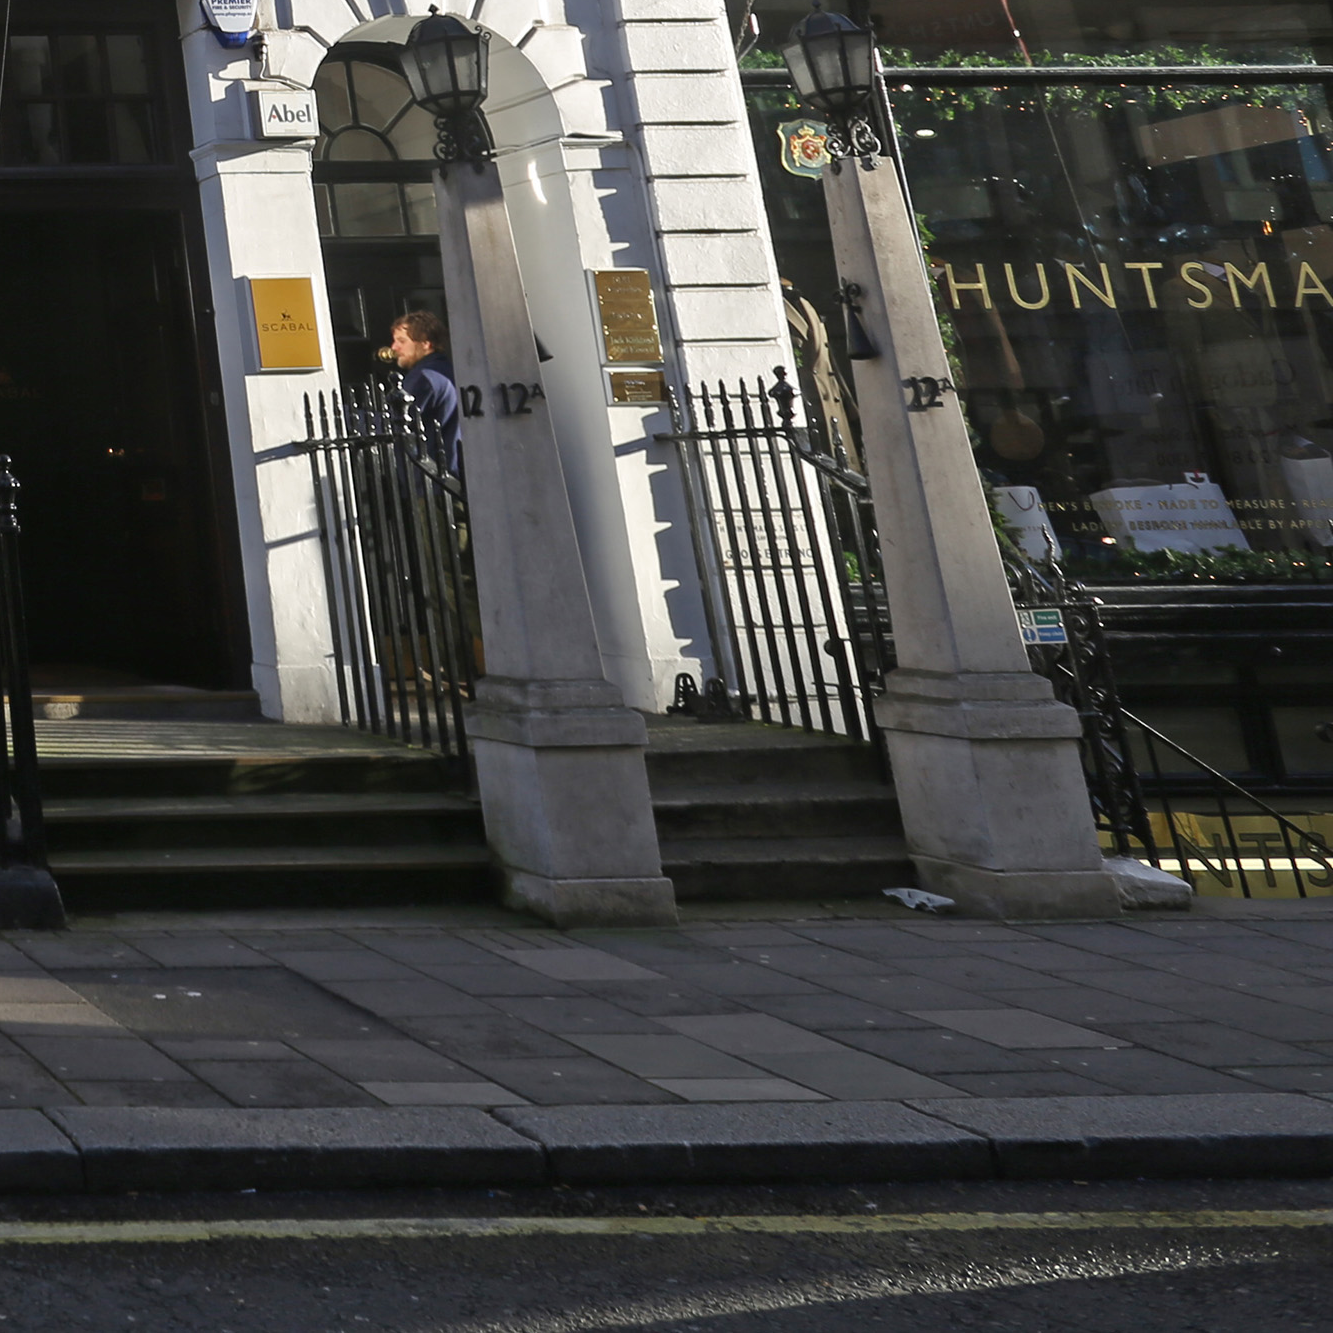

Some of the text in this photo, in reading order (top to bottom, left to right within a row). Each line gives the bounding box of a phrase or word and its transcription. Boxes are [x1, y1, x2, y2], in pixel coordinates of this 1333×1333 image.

[268, 104, 312, 123] Abel
[262, 323, 313, 332] SCABAL
[460, 384, 485, 418] 12
[1037, 501, 1078, 512] MEN'S
[1158, 499, 1197, 510] MADE
[1199, 499, 1219, 509] TO
[1225, 499, 1286, 509] MEASURE
[1302, 499, 1333, 509] REA
[1269, 519, 1284, 529] BY
